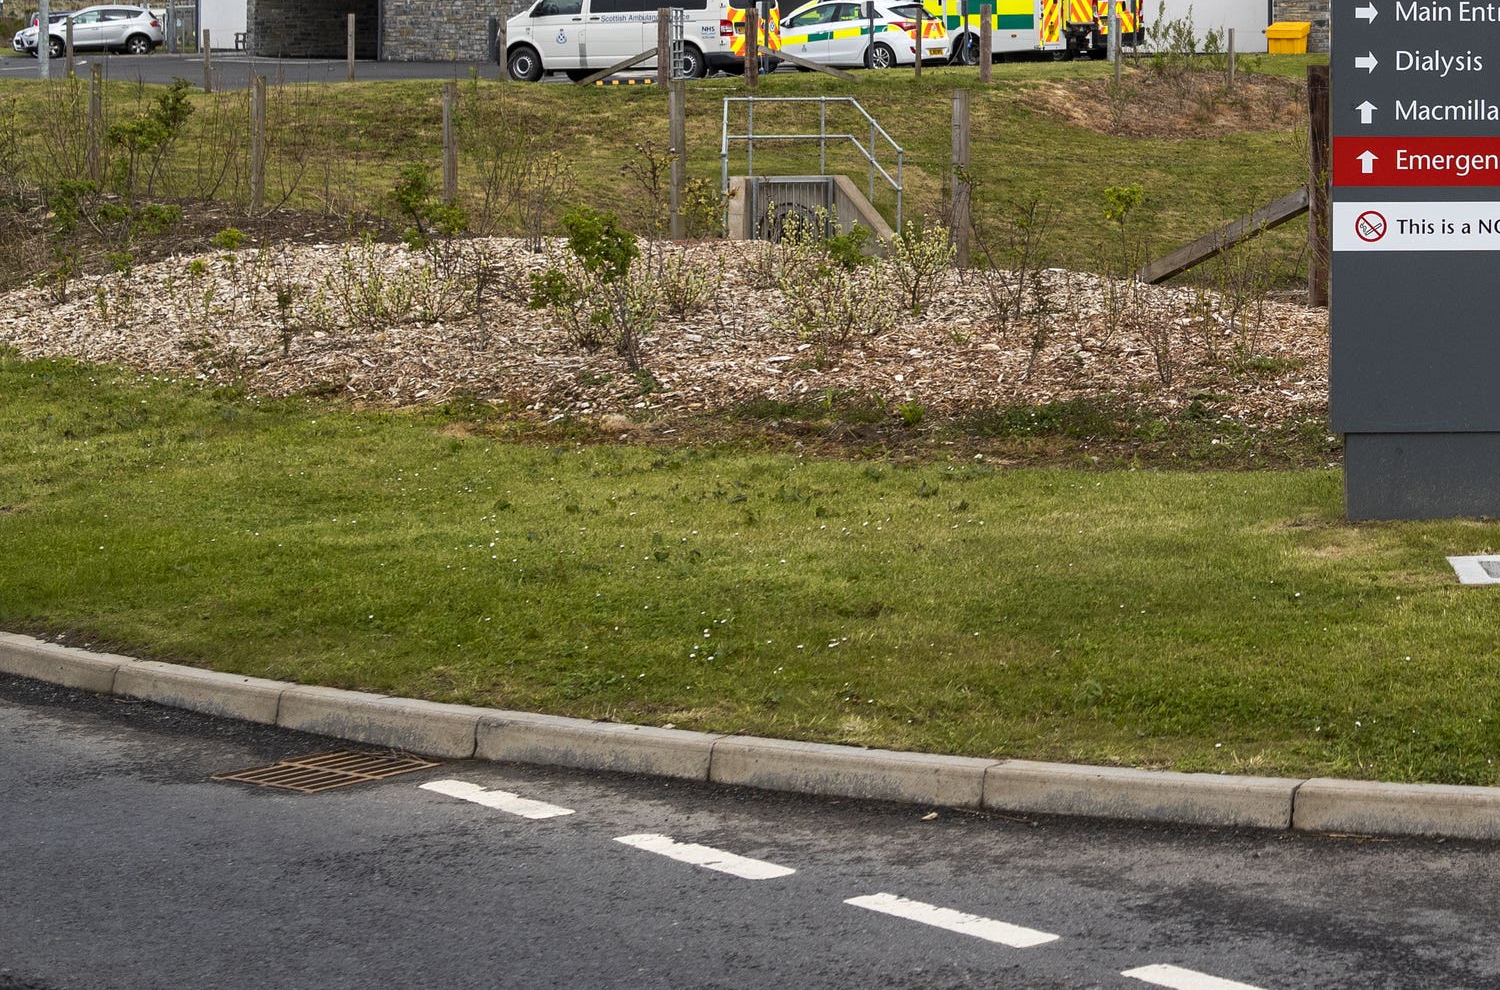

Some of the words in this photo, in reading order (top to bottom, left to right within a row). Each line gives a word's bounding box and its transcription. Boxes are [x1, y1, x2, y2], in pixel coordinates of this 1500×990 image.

[601, 14, 627, 22] Scottish
[1396, 1, 1451, 21] Main
[1397, 50, 1482, 77] Dialysis
[1397, 219, 1434, 234] This
[1442, 219, 1454, 234] is
[1462, 223, 1470, 234] a
